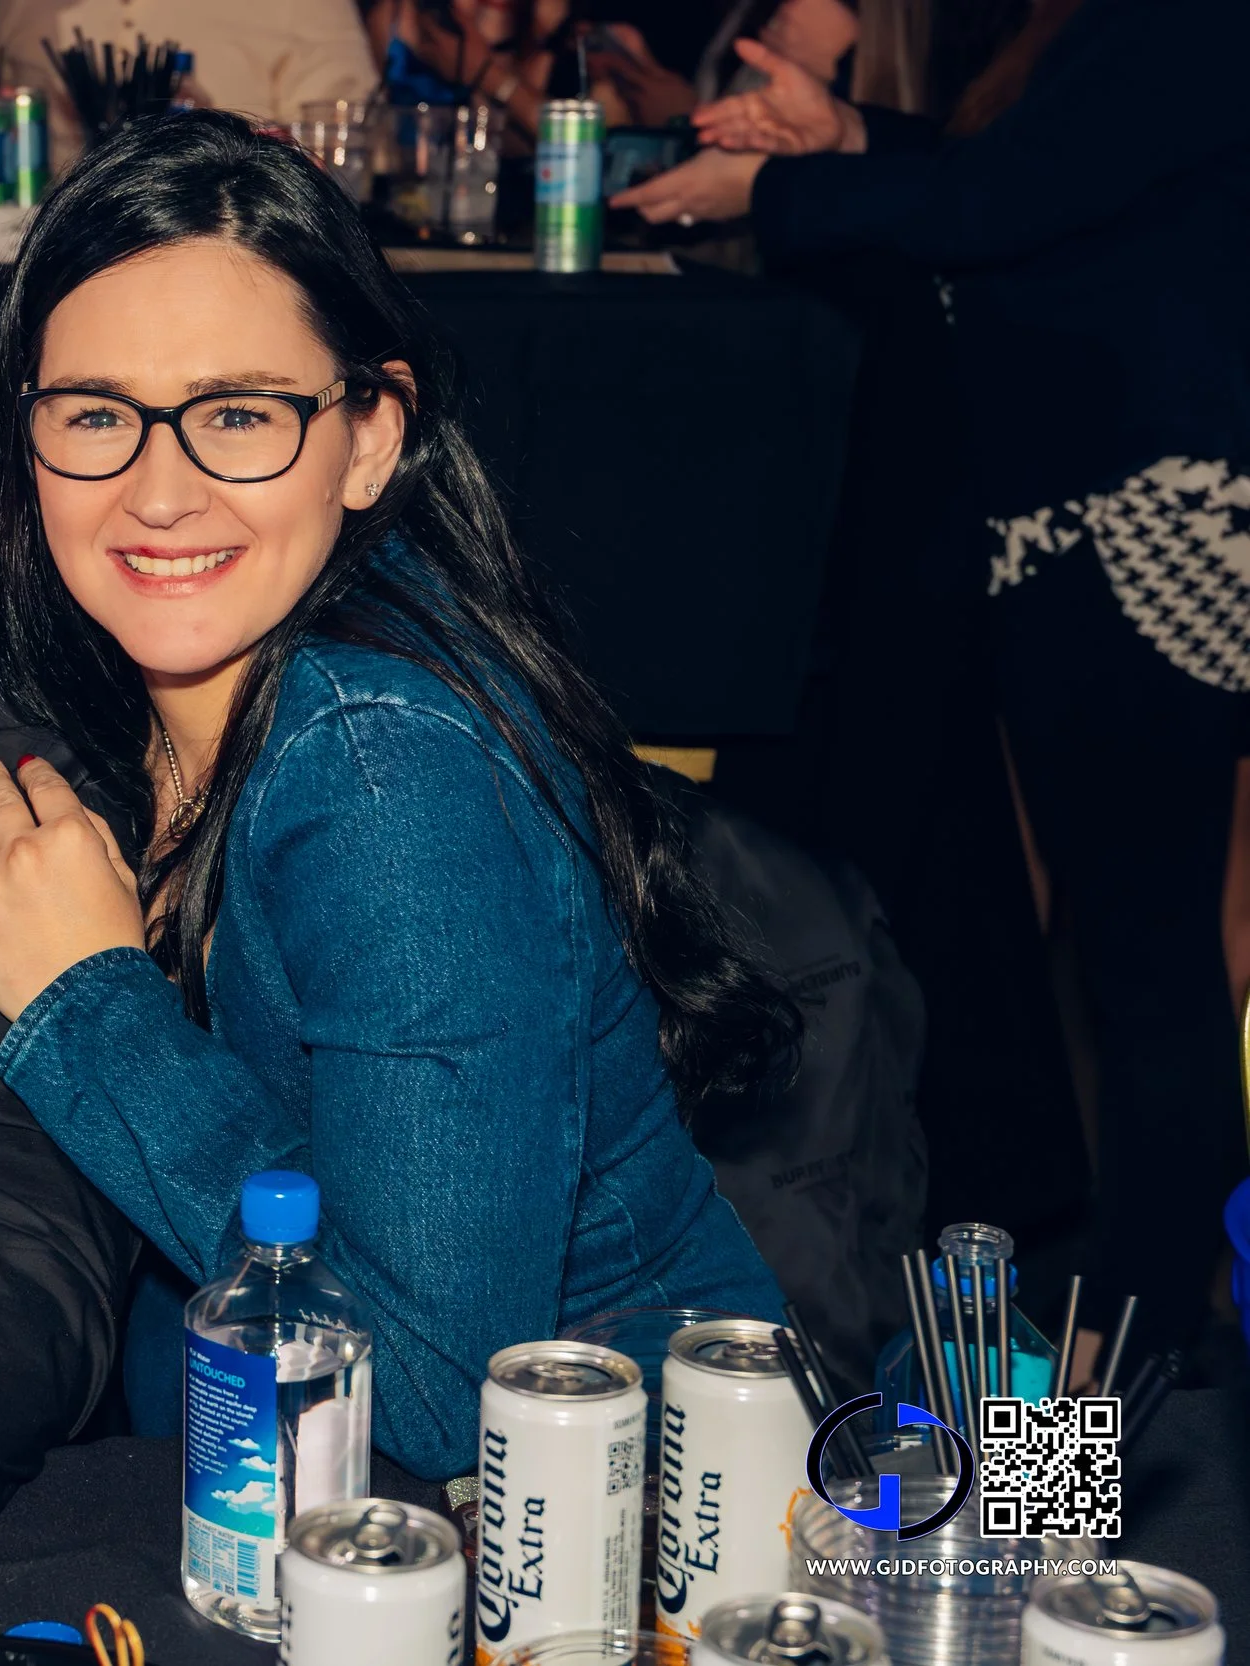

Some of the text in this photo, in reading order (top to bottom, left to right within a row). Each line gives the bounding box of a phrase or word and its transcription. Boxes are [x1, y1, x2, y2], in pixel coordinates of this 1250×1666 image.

[190, 1358, 245, 1388] UNTOUCHED
[476, 1427, 512, 1643] Corona
[508, 1496, 546, 1608] Extra
[658, 1402, 688, 1615] Corona
[684, 1471, 723, 1580] Extra
